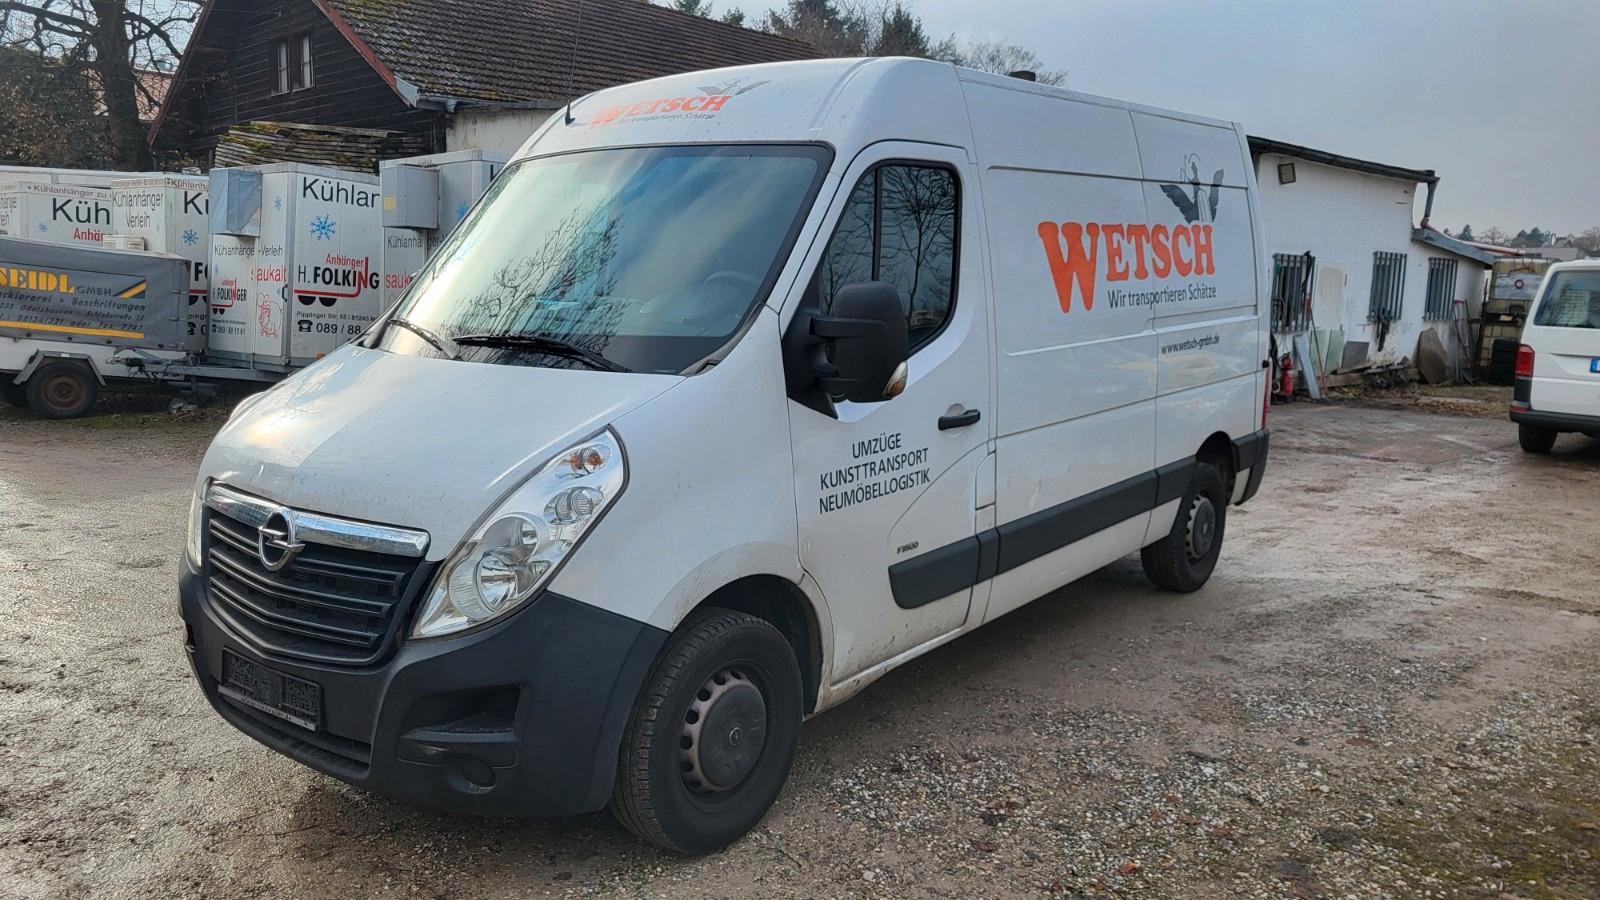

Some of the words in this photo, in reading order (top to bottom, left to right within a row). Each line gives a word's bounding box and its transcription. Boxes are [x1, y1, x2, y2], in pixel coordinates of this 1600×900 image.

[592, 96, 732, 127] WETSCH
[33, 184, 94, 198] Kühlanhänger
[113, 190, 164, 211] Kühlanhänger
[126, 211, 151, 229] Verleih
[326, 254, 364, 269] Anhänger
[1038, 221, 1216, 314] WETSCH
[77, 285, 112, 298] GMBH
[1107, 290, 1126, 309] Wir
[1128, 286, 1187, 310] transportieren
[1188, 282, 1217, 301] Schätze
[316, 322, 338, 334] 089
[347, 324, 361, 335] 88
[1161, 333, 1220, 354] www.wetsch-gmbh.de
[852, 432, 901, 459] UMZÜGE
[820, 448, 929, 490] KUNSTTRANSPORT
[819, 468, 931, 514] NEUMÖBELLOGISTIK
